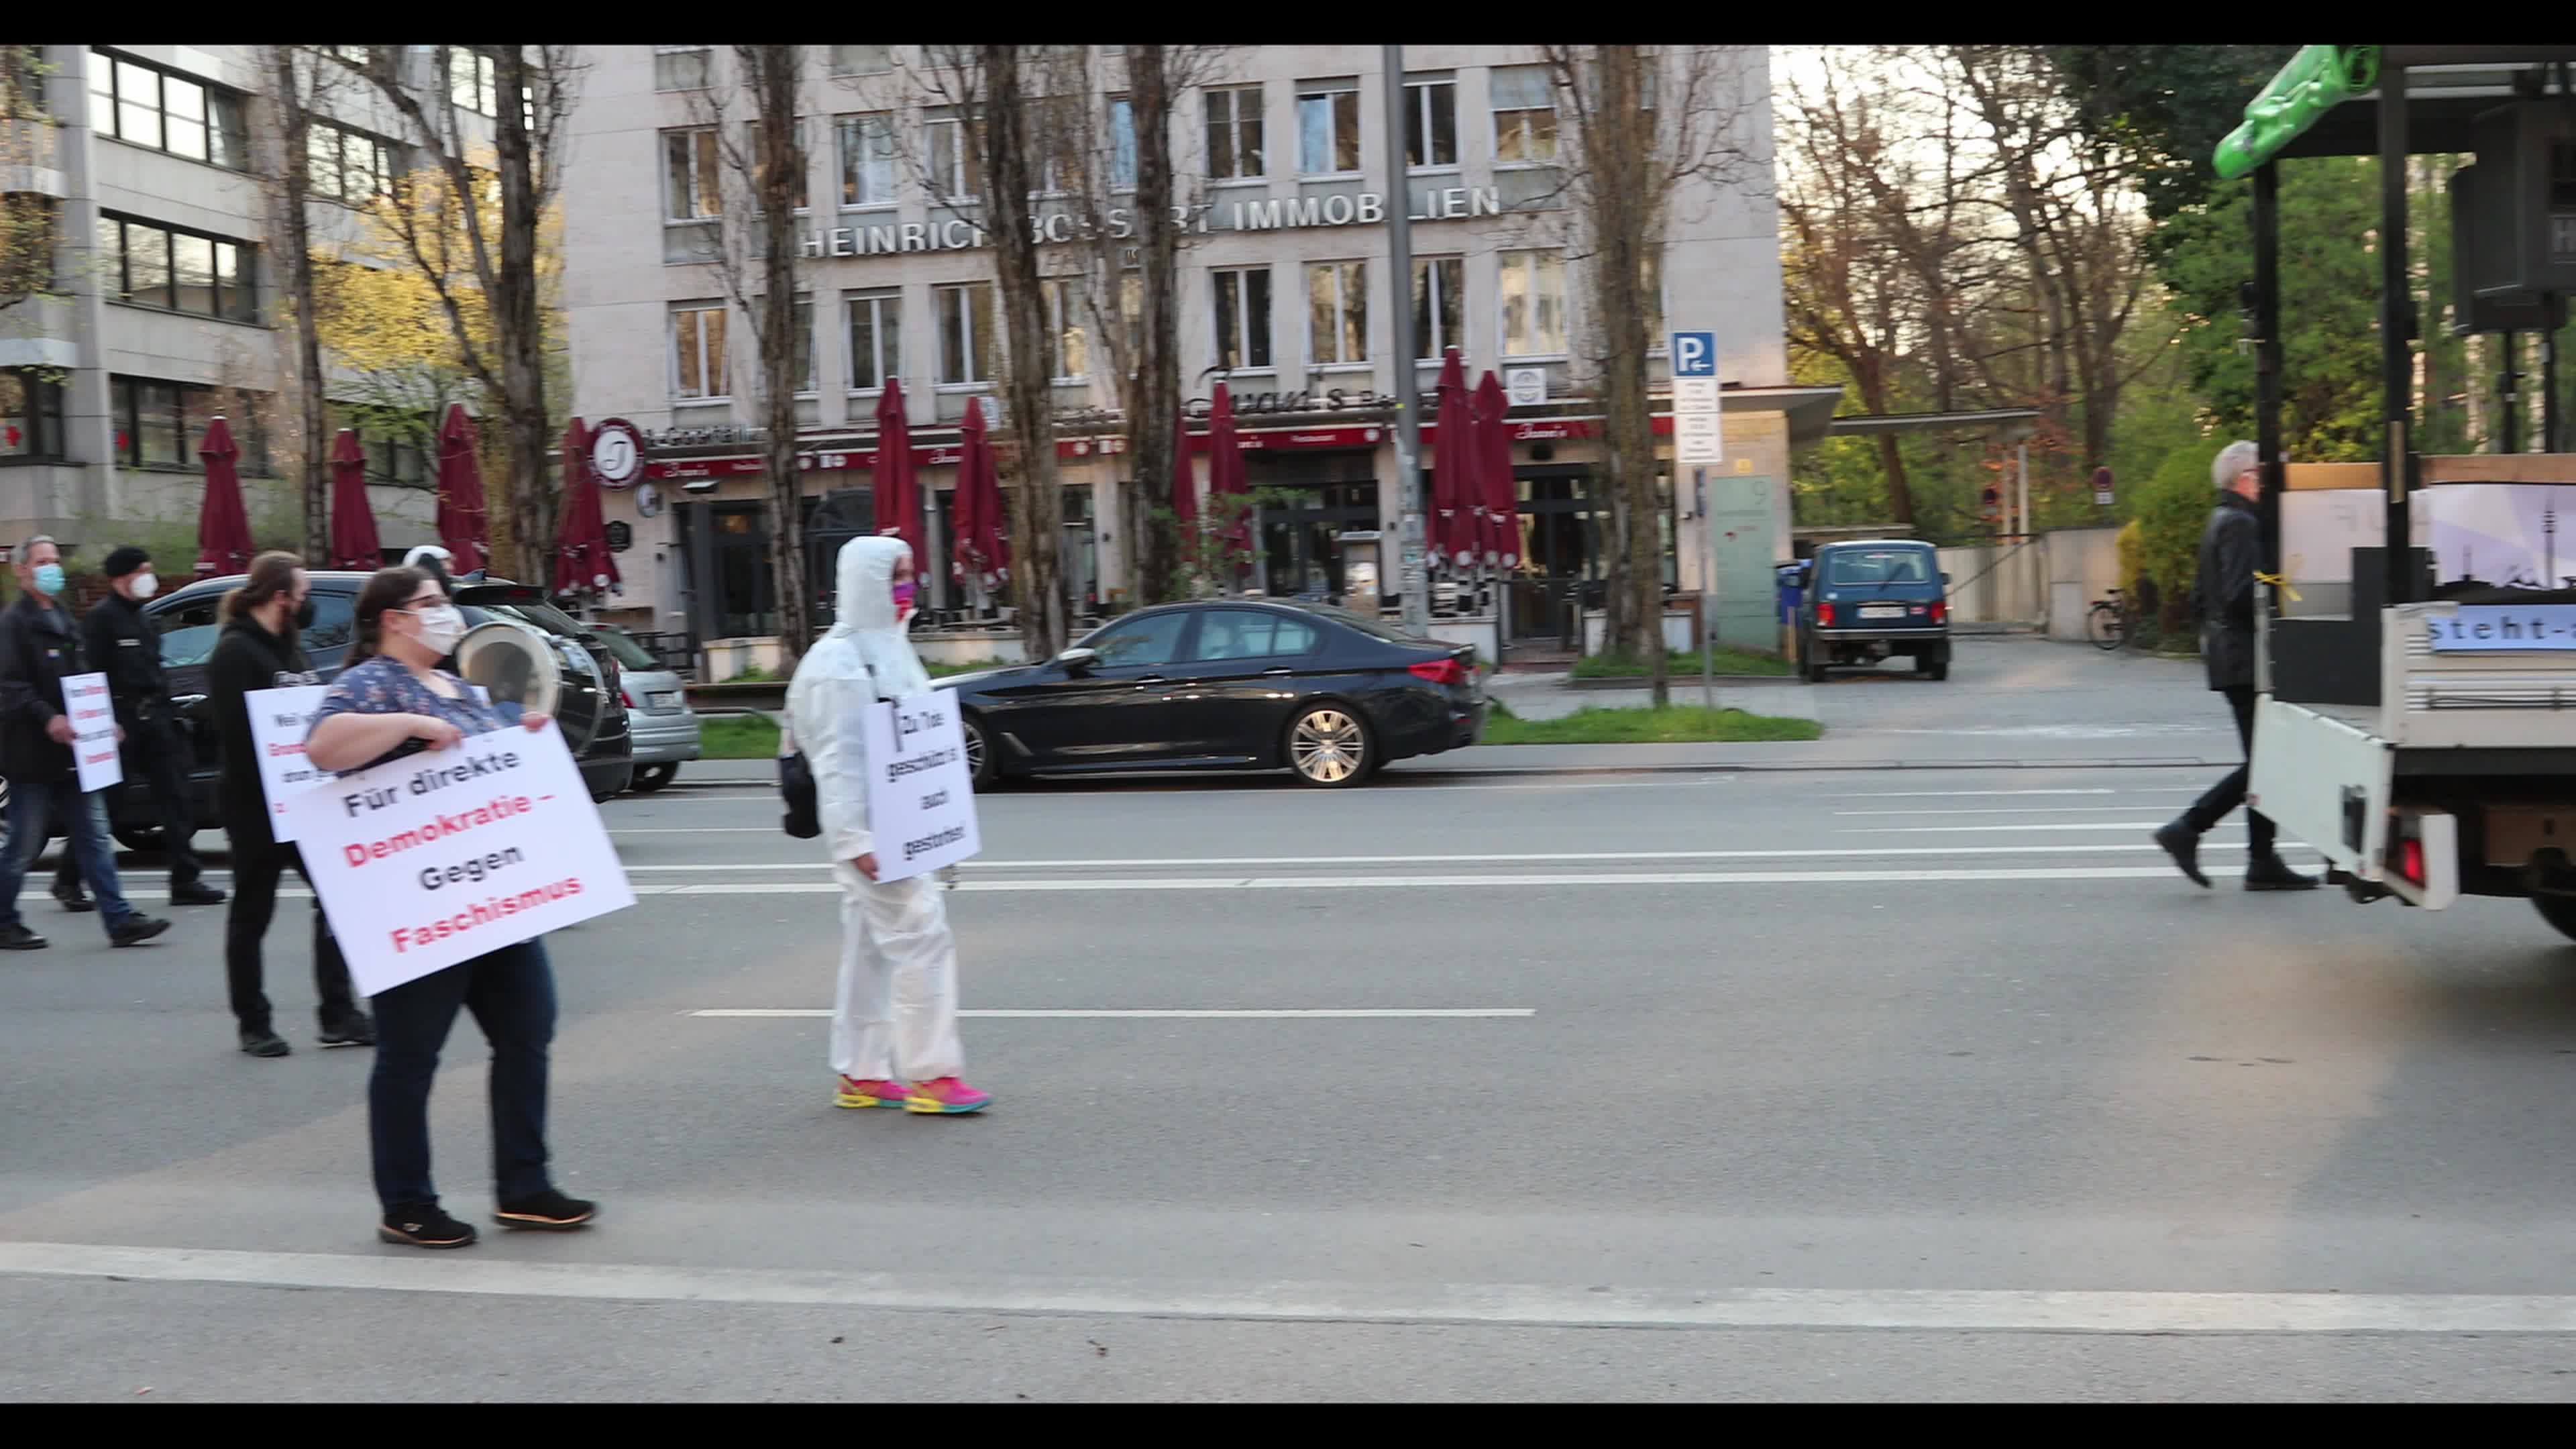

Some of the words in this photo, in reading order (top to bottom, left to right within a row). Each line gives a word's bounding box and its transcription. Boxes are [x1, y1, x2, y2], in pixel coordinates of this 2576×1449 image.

[1678, 337, 1705, 371] P
[342, 785, 400, 818] Für
[409, 751, 521, 796] direkte
[342, 794, 532, 867] Demokratie
[419, 845, 525, 891] Gegen
[389, 876, 584, 953] Faschismus
